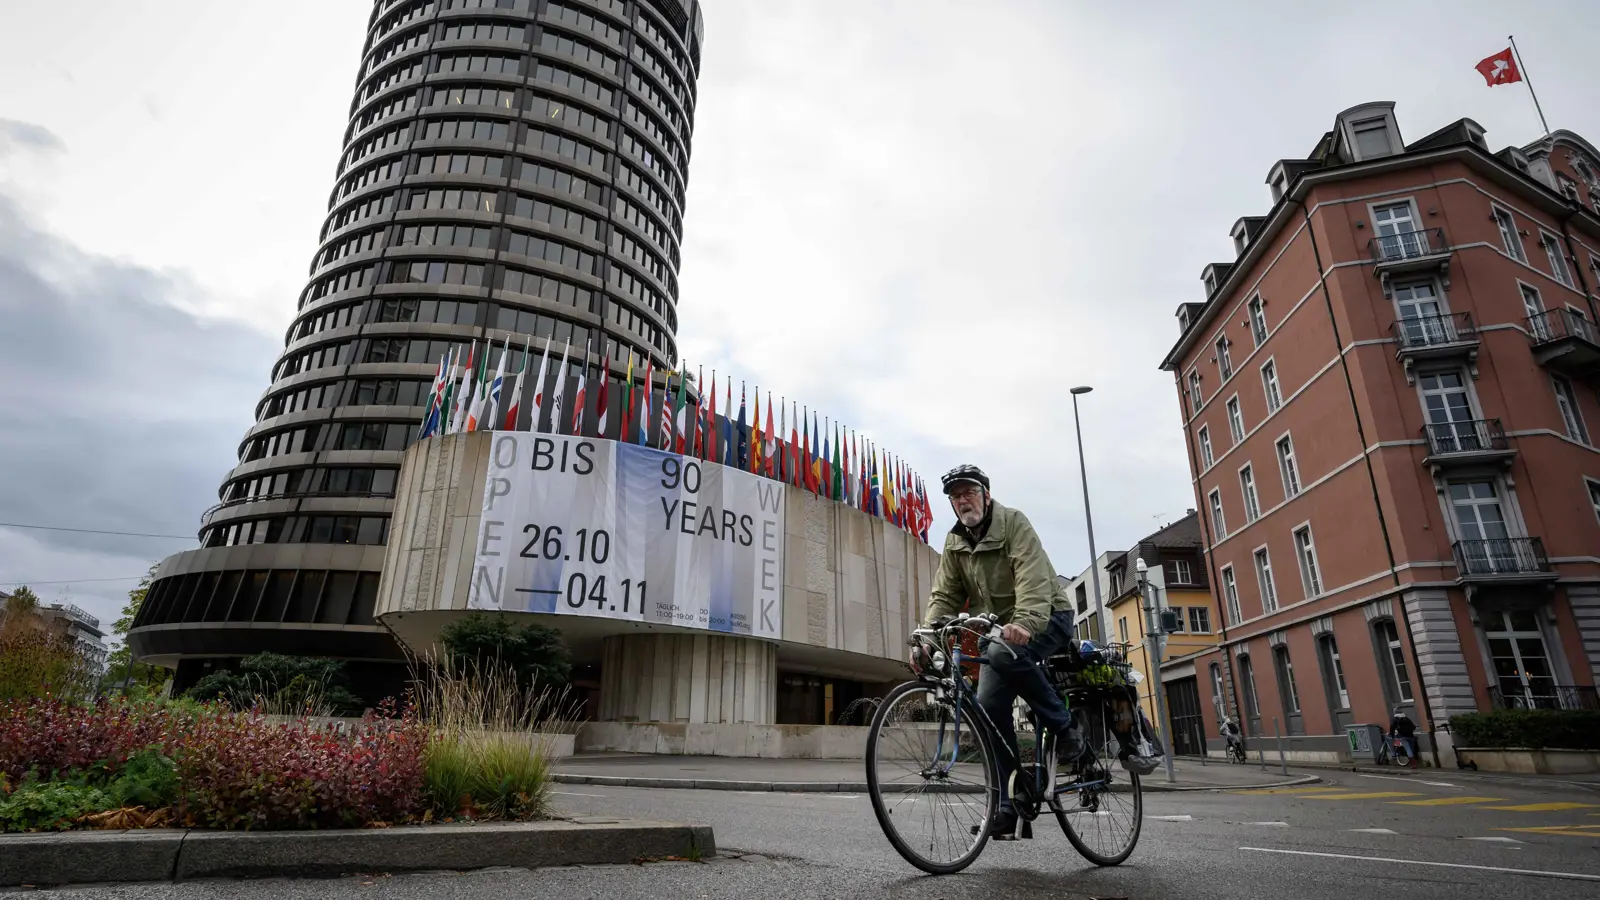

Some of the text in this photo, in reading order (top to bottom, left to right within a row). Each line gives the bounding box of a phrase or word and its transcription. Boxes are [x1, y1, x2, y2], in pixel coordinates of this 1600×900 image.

[531, 437, 596, 475] BIS
[661, 457, 702, 494] 90
[473, 435, 518, 604] OPEN
[660, 496, 754, 547] YEARS
[519, 524, 610, 565] 26.10
[756, 480, 781, 633] WEEK
